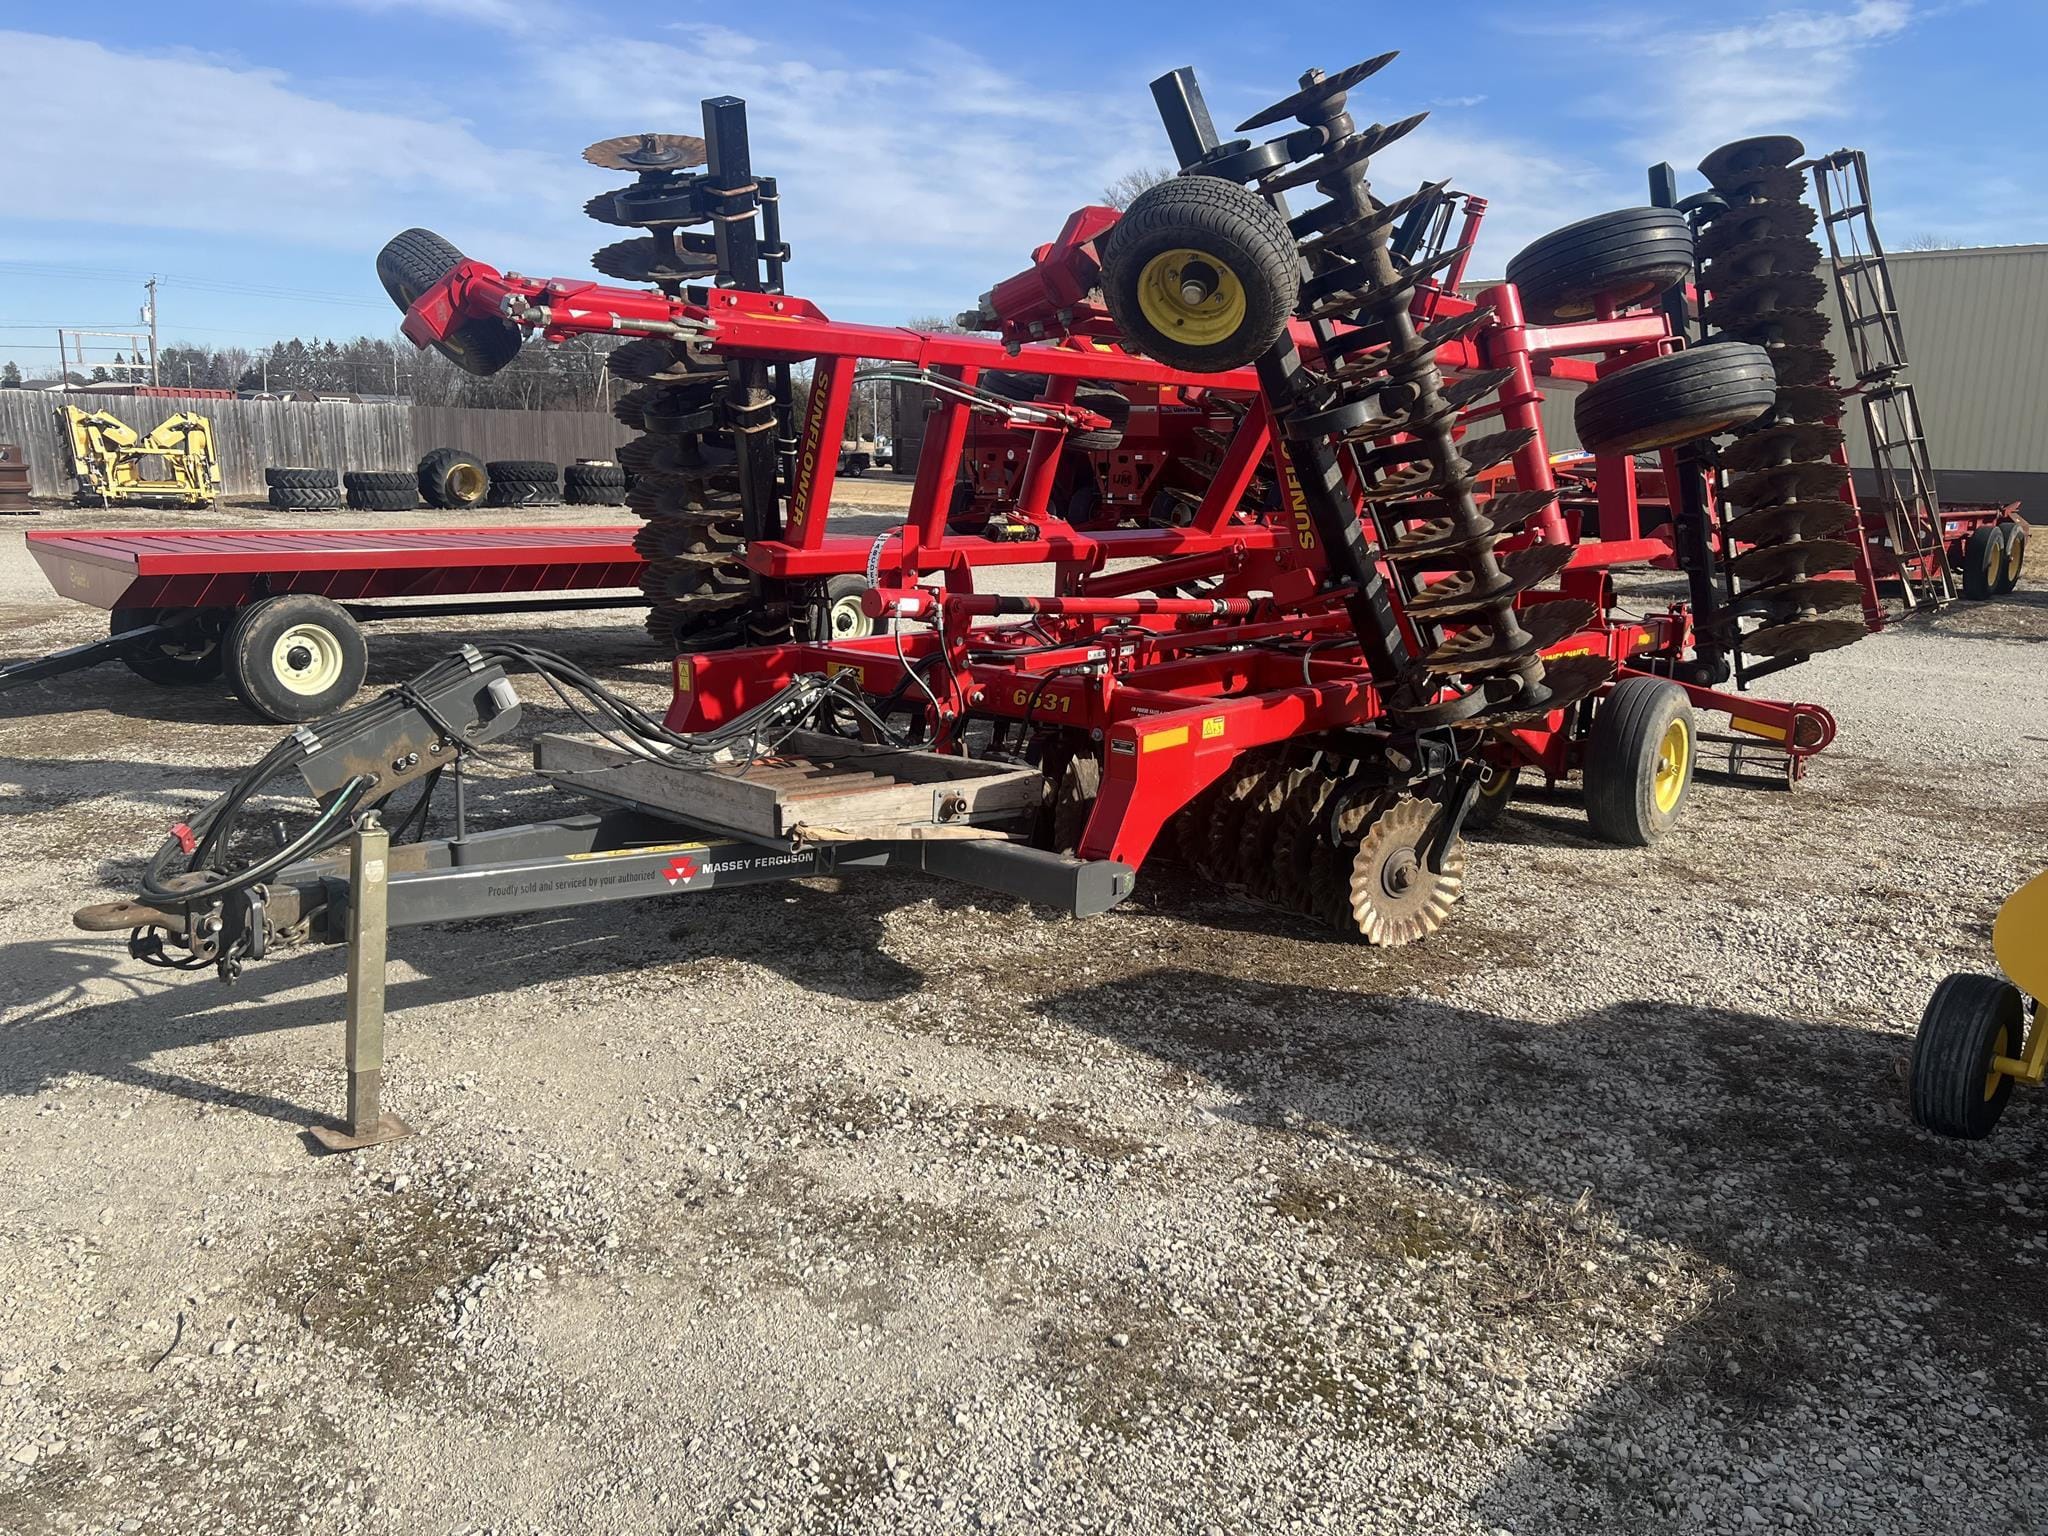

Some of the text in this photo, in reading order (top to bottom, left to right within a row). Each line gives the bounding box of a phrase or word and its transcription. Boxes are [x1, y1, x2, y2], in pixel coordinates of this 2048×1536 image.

[792, 370, 829, 527] SUNFLOWER
[1013, 689, 1071, 713] 6631
[702, 852, 814, 874] MASSEY FERGUSON
[488, 870, 656, 897] Proudly sold and serviced by your authorized
